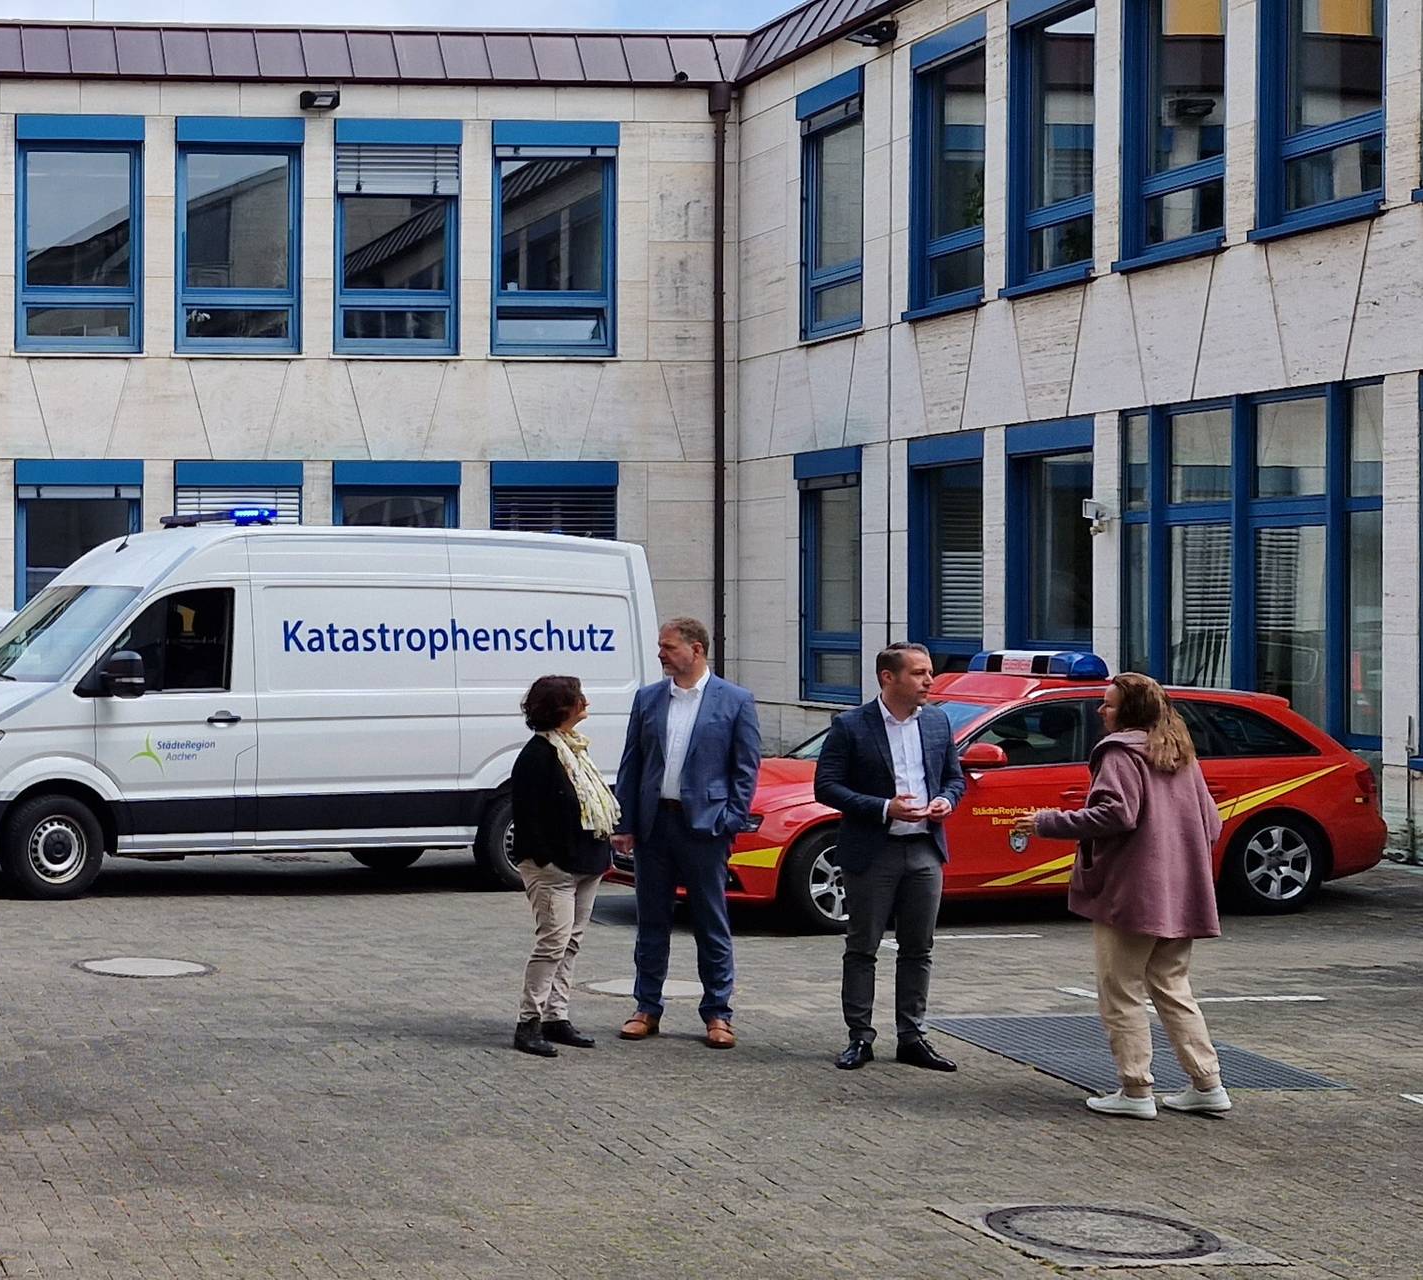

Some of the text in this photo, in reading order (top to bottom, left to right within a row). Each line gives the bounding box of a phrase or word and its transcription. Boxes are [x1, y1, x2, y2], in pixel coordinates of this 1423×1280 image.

[283, 618, 615, 660] Katastrophenschutz
[157, 740, 216, 751] StädteRegion
[166, 752, 197, 760] Aachen
